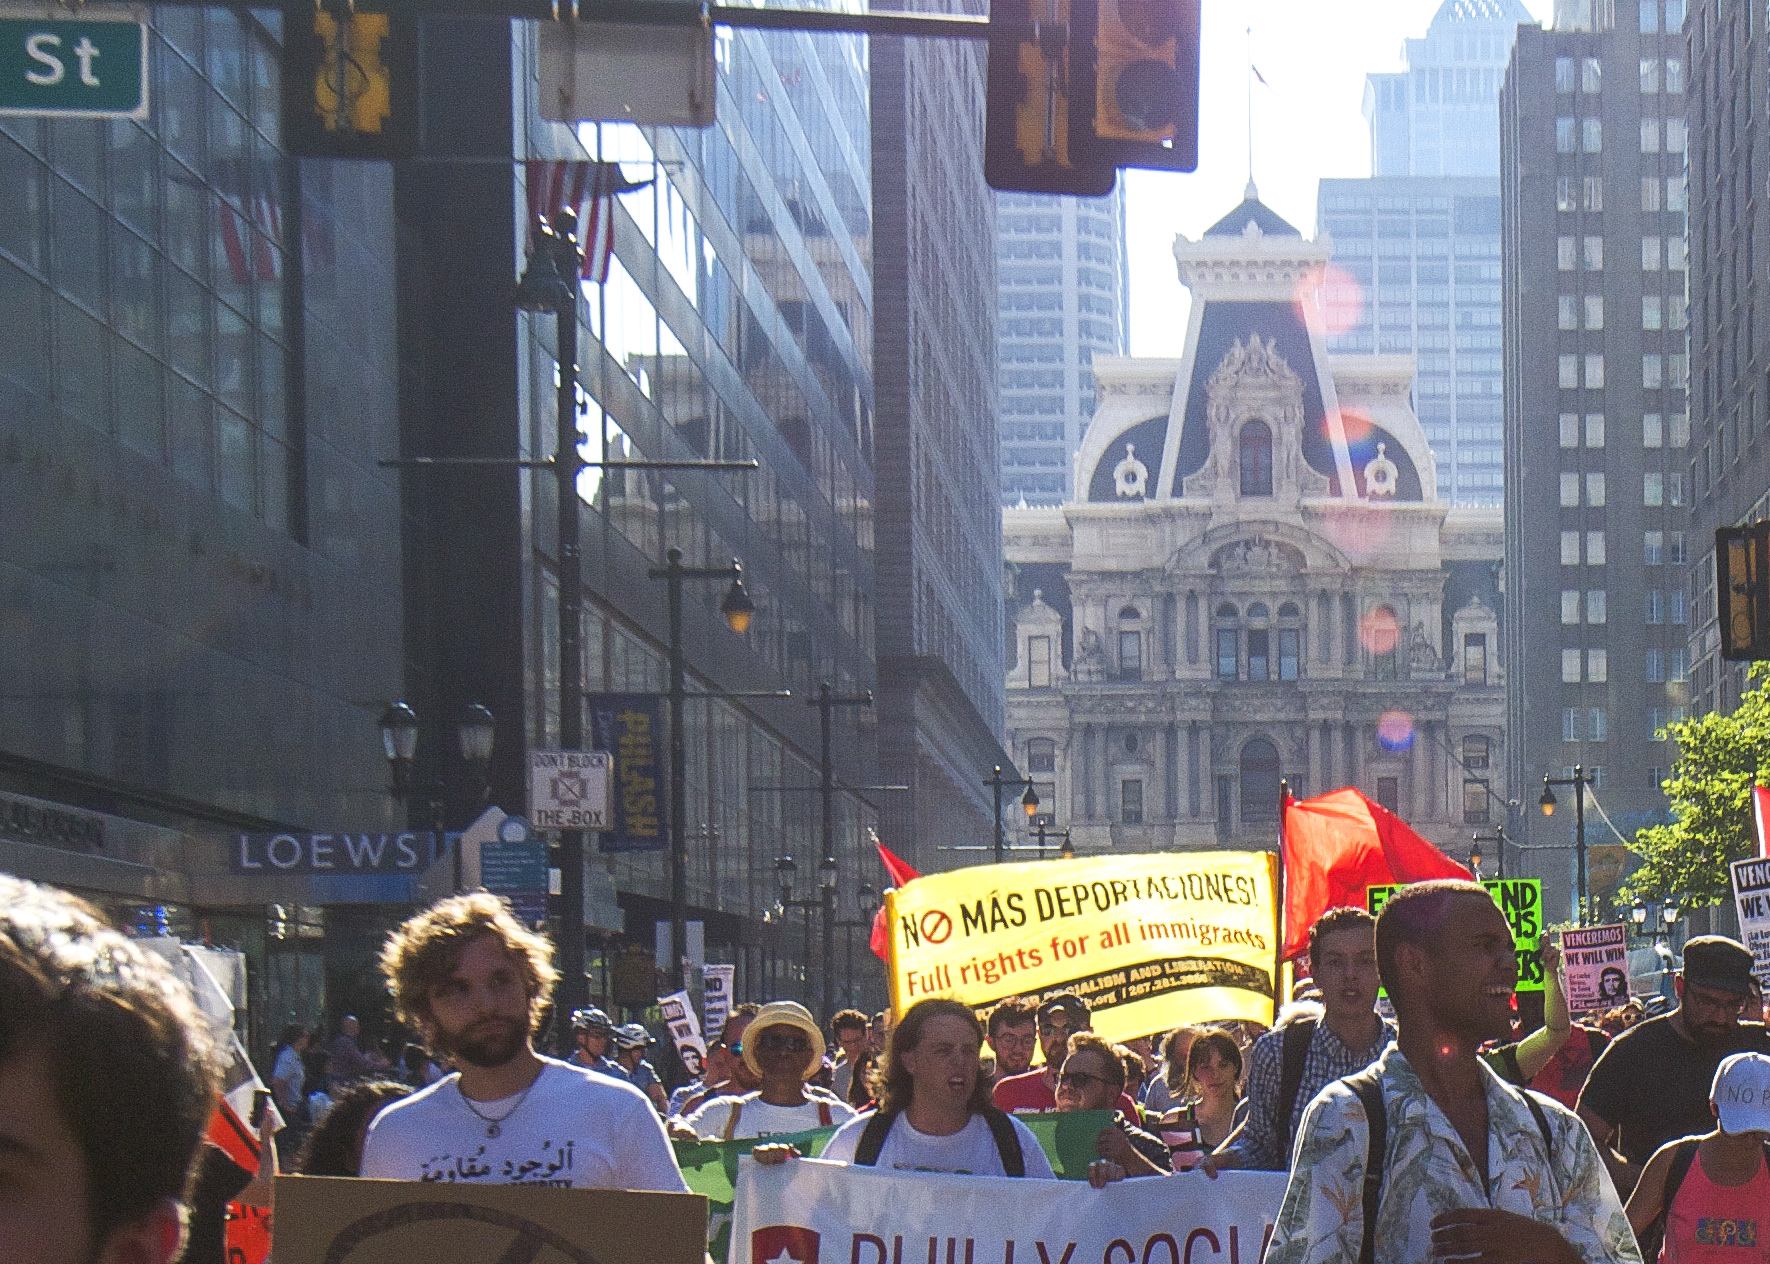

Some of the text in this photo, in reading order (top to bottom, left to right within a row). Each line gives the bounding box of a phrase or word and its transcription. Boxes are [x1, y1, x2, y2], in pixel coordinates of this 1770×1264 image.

[24, 34, 101, 88] St
[536, 809, 604, 826] THE BOX
[240, 833, 419, 871] LOEWS
[960, 887, 1026, 938] MÁS
[1034, 873, 1258, 923] DEPORTACIONES!
[1740, 896, 1765, 919] WE
[1564, 928, 1623, 948] VENCEREMOS
[906, 918, 1267, 998] Full rights for all immigrants
[1565, 952, 1581, 966] WE
[1581, 950, 1605, 966] WILL
[1128, 963, 1163, 984] AND
